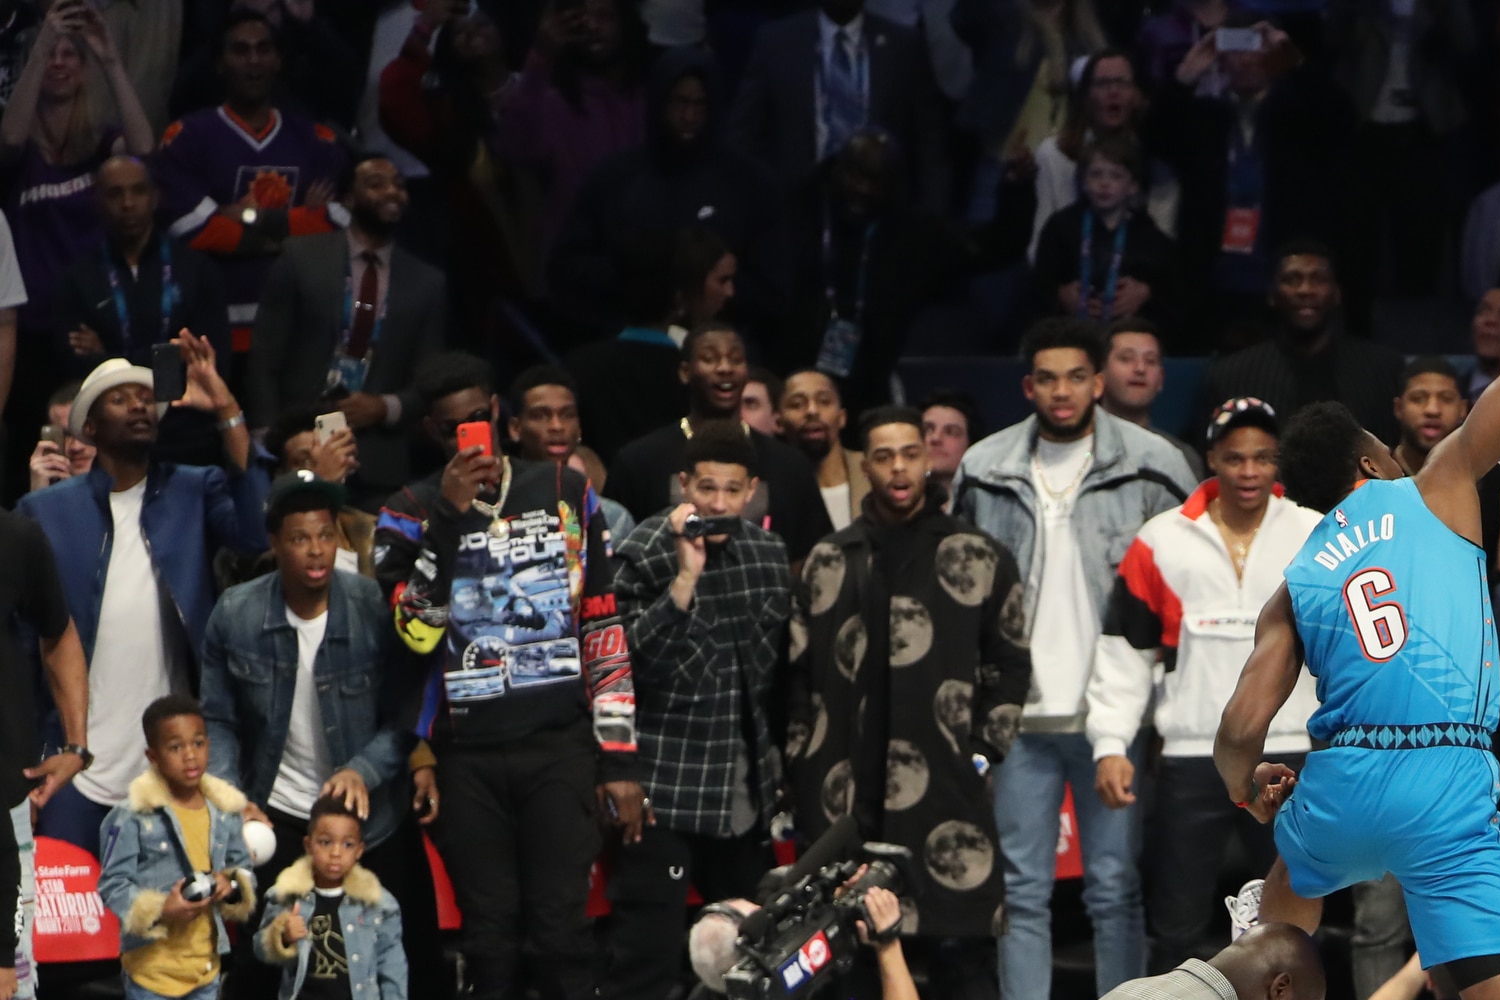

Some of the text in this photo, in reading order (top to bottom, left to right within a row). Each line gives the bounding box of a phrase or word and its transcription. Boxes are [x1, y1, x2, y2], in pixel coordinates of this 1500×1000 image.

[1314, 513, 1394, 571] DIALLO
[582, 593, 617, 618] 3M
[1342, 567, 1409, 663] 6
[34, 891, 105, 917] SATURDAY
